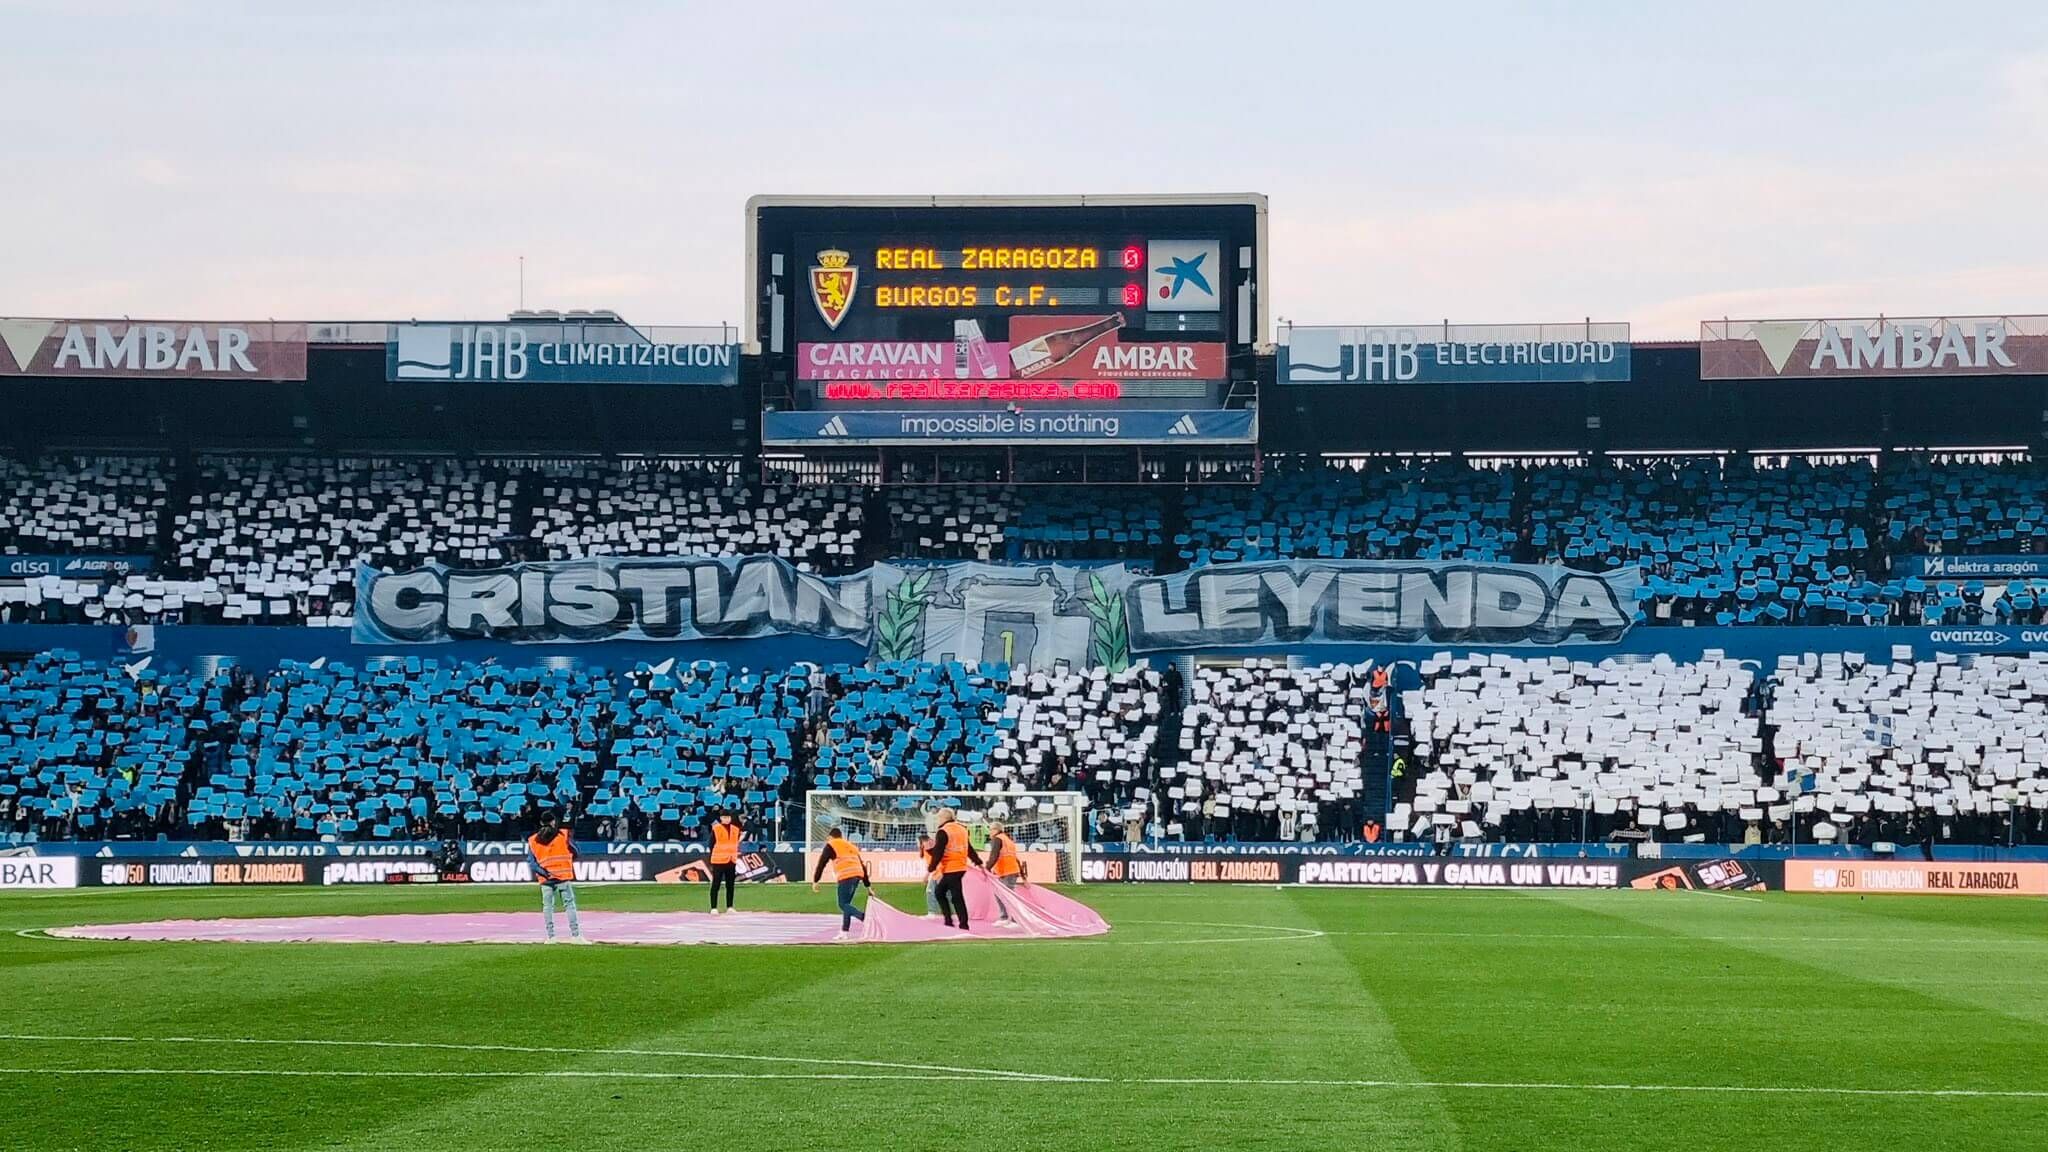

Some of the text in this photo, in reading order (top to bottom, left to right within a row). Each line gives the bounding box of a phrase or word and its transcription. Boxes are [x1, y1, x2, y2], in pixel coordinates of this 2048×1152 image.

[876, 248, 1098, 269] REAL ZARAGOZA
[1122, 248, 1140, 269] 0
[876, 286, 1059, 306] BURGOS C.F.
[53, 325, 258, 372] AMBAR
[454, 327, 730, 379] JAB CLIMATIZACION
[810, 343, 942, 365] CARAVAN
[1346, 328, 1615, 381] JAB ELECTRICIDAD
[1810, 323, 2017, 369] AMBAR
[1093, 346, 1198, 370] AMBAR
[811, 369, 942, 379] FRAGANCIAS
[826, 380, 1120, 399] www.realzaragoza.com
[901, 413, 1119, 436] impossible is nothing
[11, 560, 49, 573] alsa
[1947, 556, 2038, 575] elektra aragón
[370, 560, 868, 636] CRISTIAN
[1134, 568, 1631, 642] LEYENDA
[1930, 630, 1994, 642] avanza
[101, 860, 304, 884] 50/50 FUNDACIÓN REAL ZARAGOZA
[470, 862, 532, 882] GANA
[574, 861, 642, 881] VIAJE!
[735, 852, 764, 874] 0/50
[1082, 858, 1279, 881] 50/50 FUNDACIÓN REAL ZARAGOZA
[1299, 862, 1617, 885] ¡PARTICIPA Y GANA UN VIAJE!
[1697, 859, 1744, 885] 50/50
[1812, 866, 2019, 889] 50/50 FUNDACIÓN REAL ZARAGOZA
